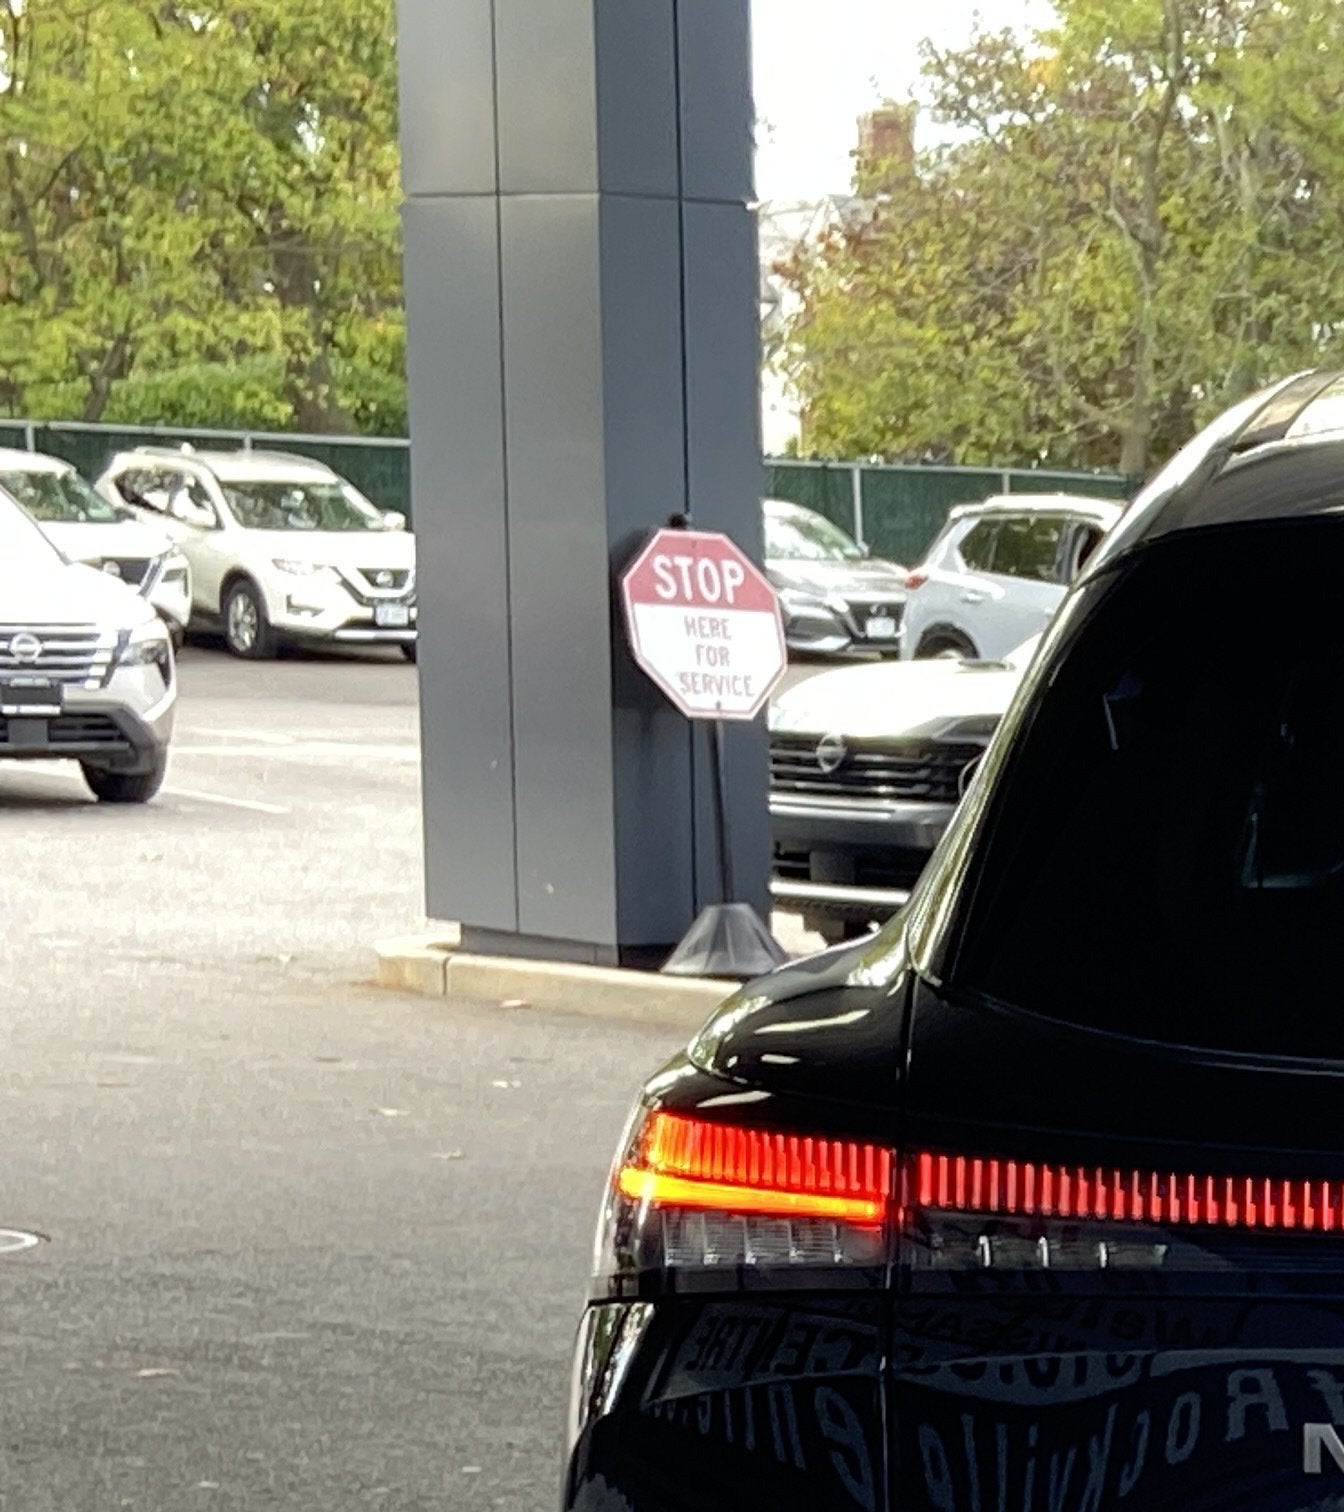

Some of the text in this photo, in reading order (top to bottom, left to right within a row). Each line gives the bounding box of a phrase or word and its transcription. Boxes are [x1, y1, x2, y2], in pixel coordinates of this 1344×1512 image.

[652, 554, 745, 605] STOP
[683, 615, 732, 641] HERE
[694, 644, 731, 668] FOR
[677, 671, 755, 698] SERVICE
